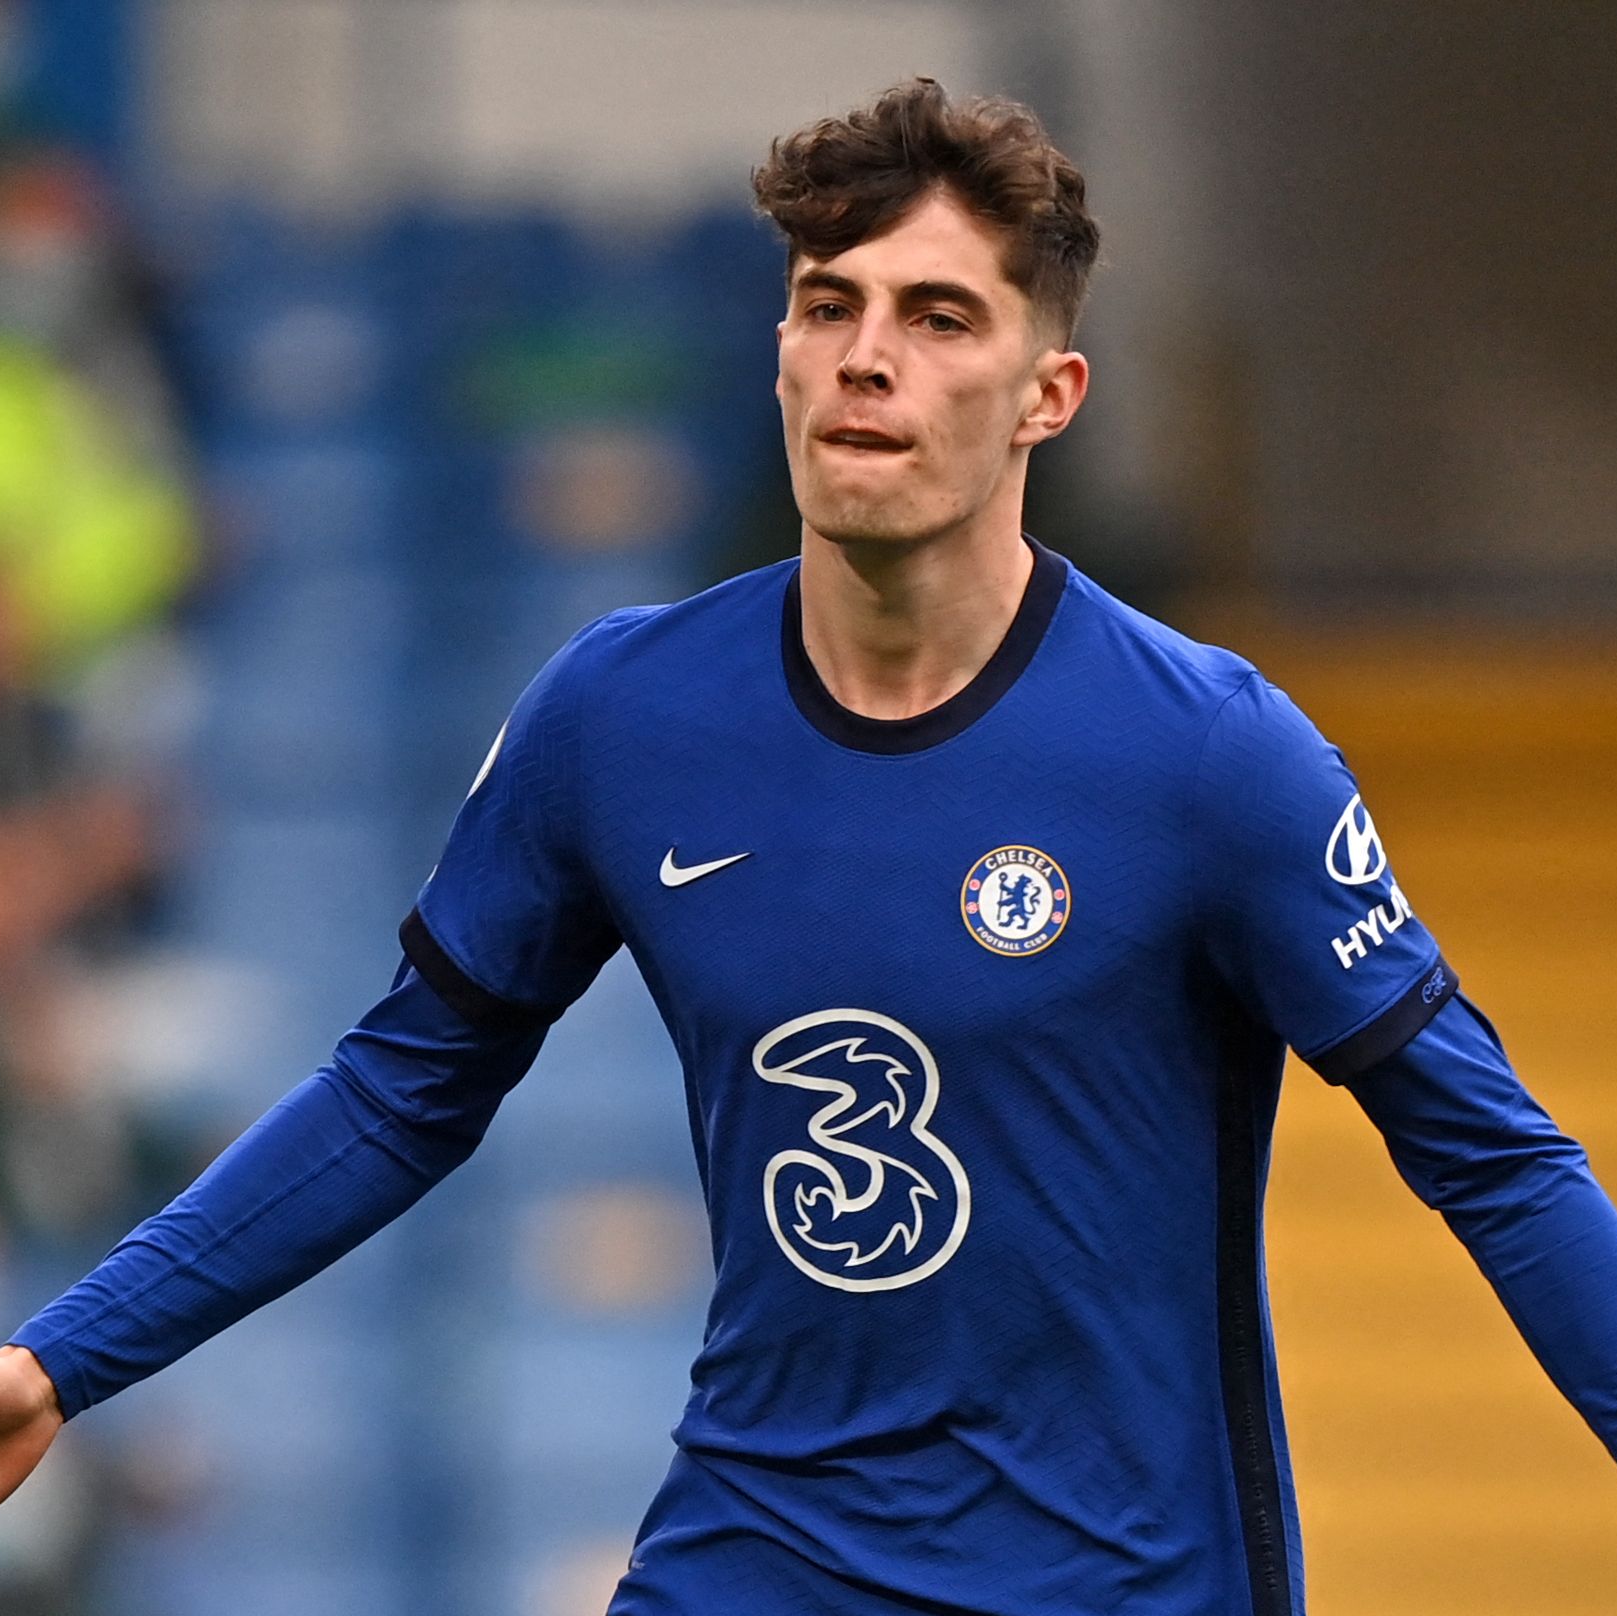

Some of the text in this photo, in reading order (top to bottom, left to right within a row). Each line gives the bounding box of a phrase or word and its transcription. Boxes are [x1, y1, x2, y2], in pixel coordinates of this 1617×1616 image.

[985, 850, 1053, 878] CHELSEA
[976, 926, 1048, 951] FOOTBALL CLUB
[752, 1008, 971, 1292] 3
